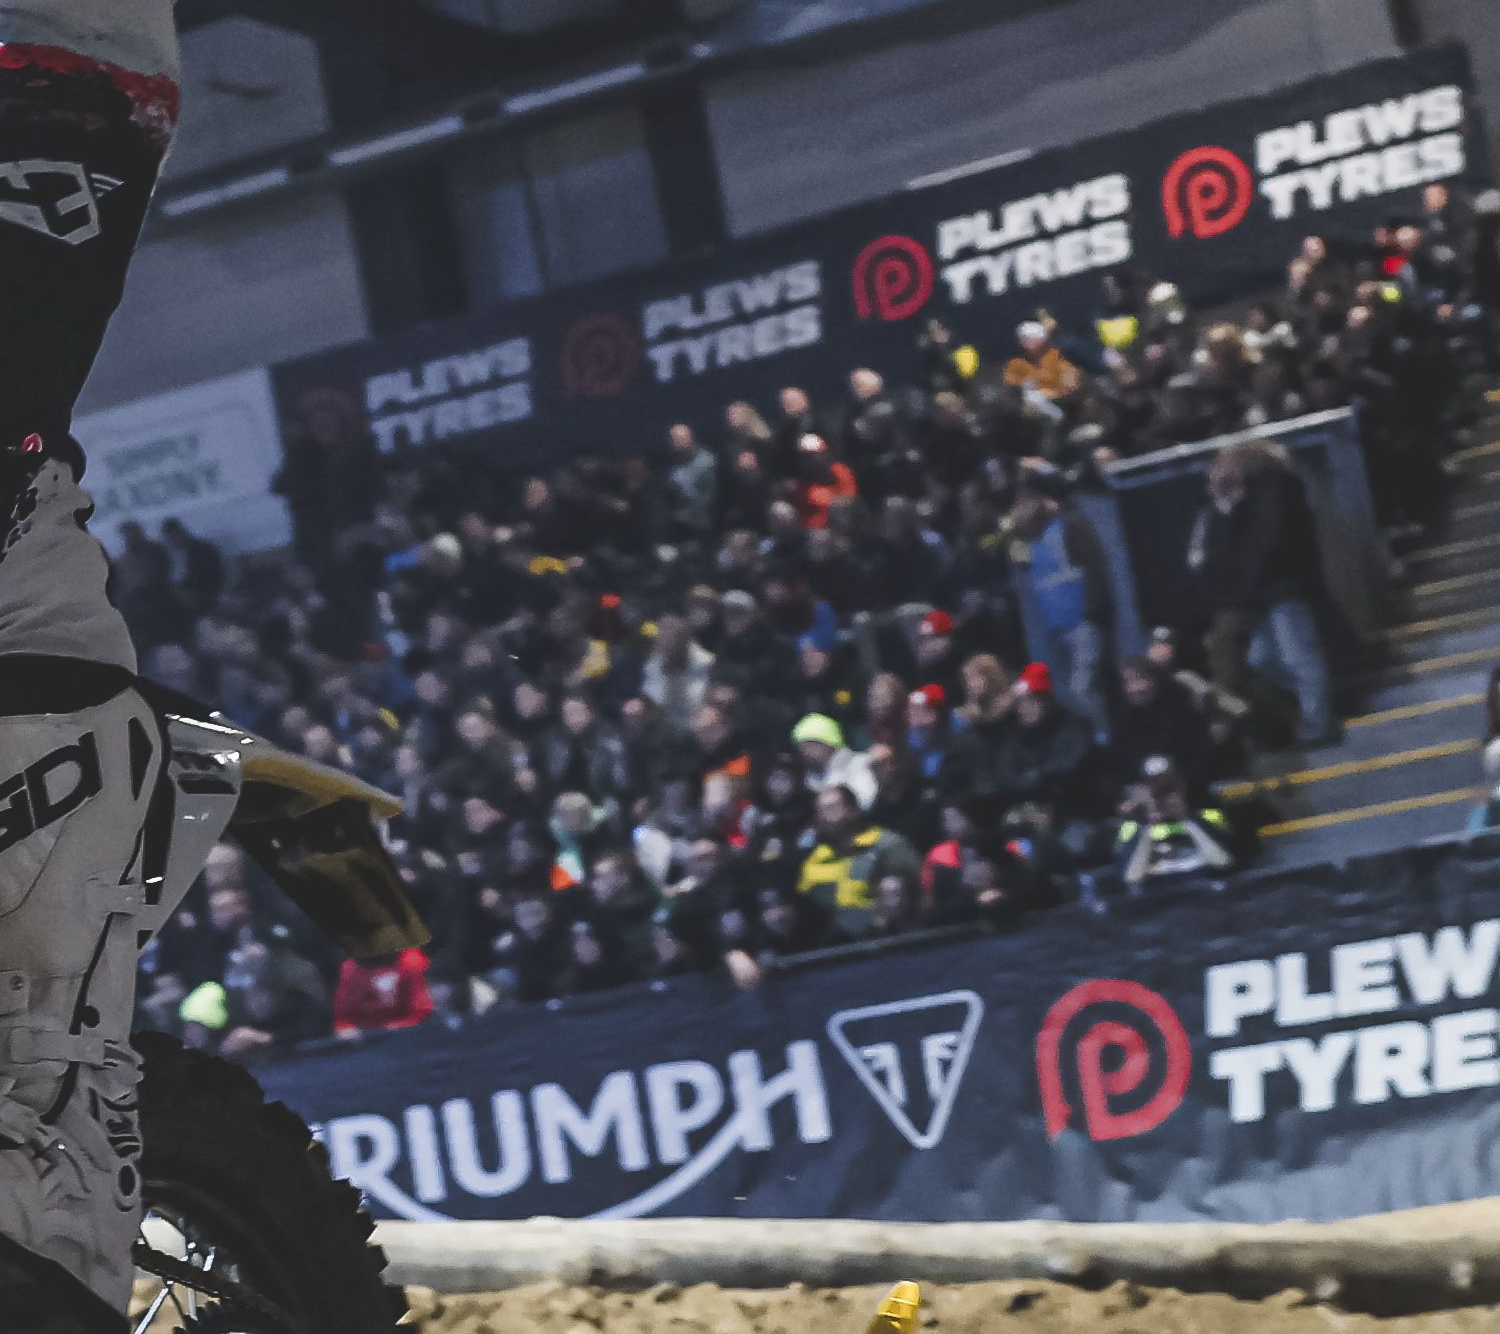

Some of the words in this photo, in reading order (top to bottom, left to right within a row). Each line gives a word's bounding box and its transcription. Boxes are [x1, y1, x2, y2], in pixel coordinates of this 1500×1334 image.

[1254, 84, 1465, 174] PLEWS
[935, 171, 1132, 261] PLEWS
[1258, 131, 1467, 220] TYRES
[640, 259, 824, 342] PLEWS
[940, 218, 1134, 305] TYRES
[362, 336, 533, 414] PLEWS
[645, 305, 826, 385] TYRES
[366, 381, 534, 455] TYRES
[310, 1039, 834, 1219] RIUMPH
